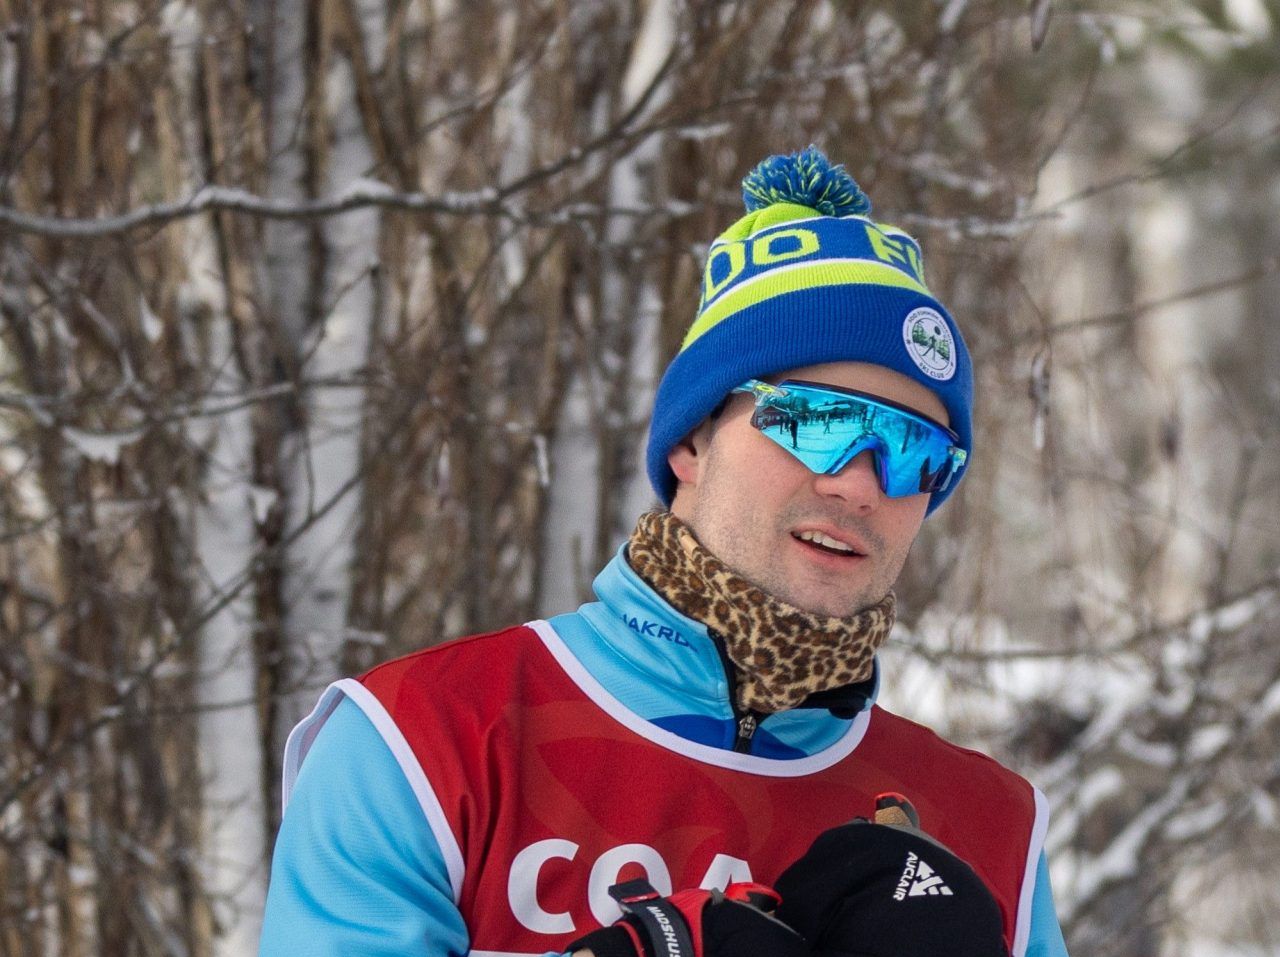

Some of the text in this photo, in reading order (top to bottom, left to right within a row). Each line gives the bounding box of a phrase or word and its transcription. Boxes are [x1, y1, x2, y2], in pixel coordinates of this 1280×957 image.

[701, 225, 925, 306] OO FI
[893, 851, 919, 901] AUCLAIR
